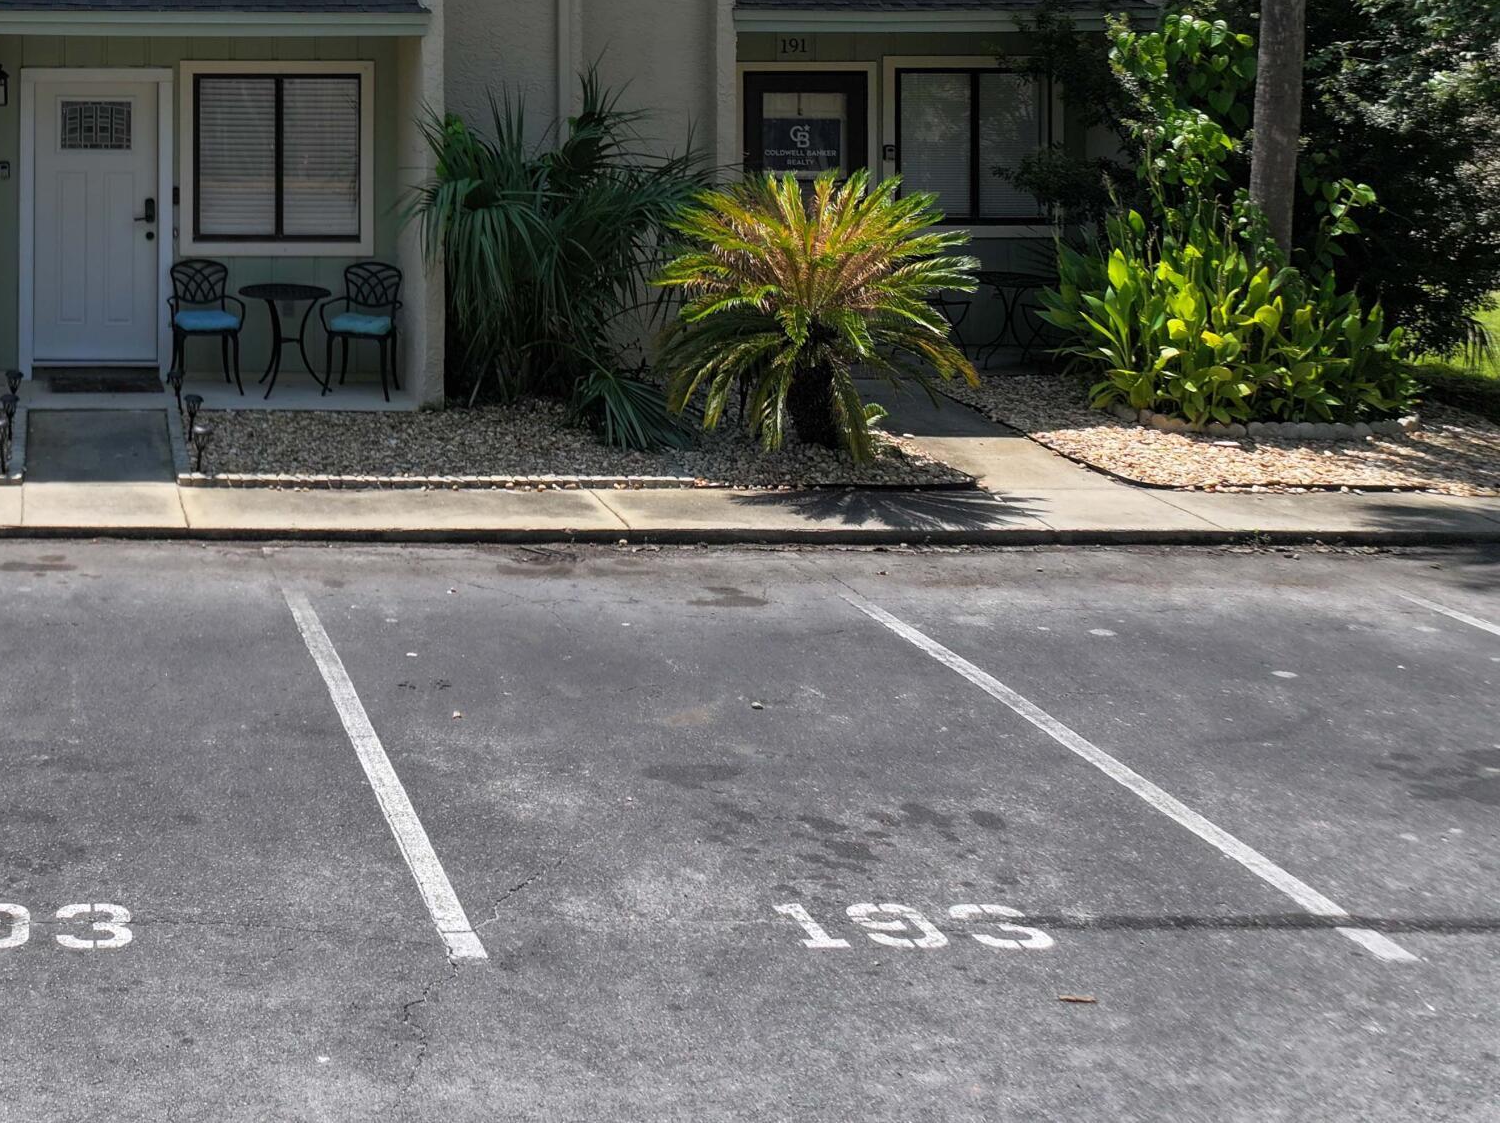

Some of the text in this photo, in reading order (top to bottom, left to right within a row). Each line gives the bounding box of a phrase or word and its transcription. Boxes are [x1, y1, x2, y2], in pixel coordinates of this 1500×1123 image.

[780, 38, 807, 54] 191
[764, 149, 837, 157] COLDWELL BANKER
[786, 158, 814, 166] REALTY
[772, 902, 1055, 949] 193
